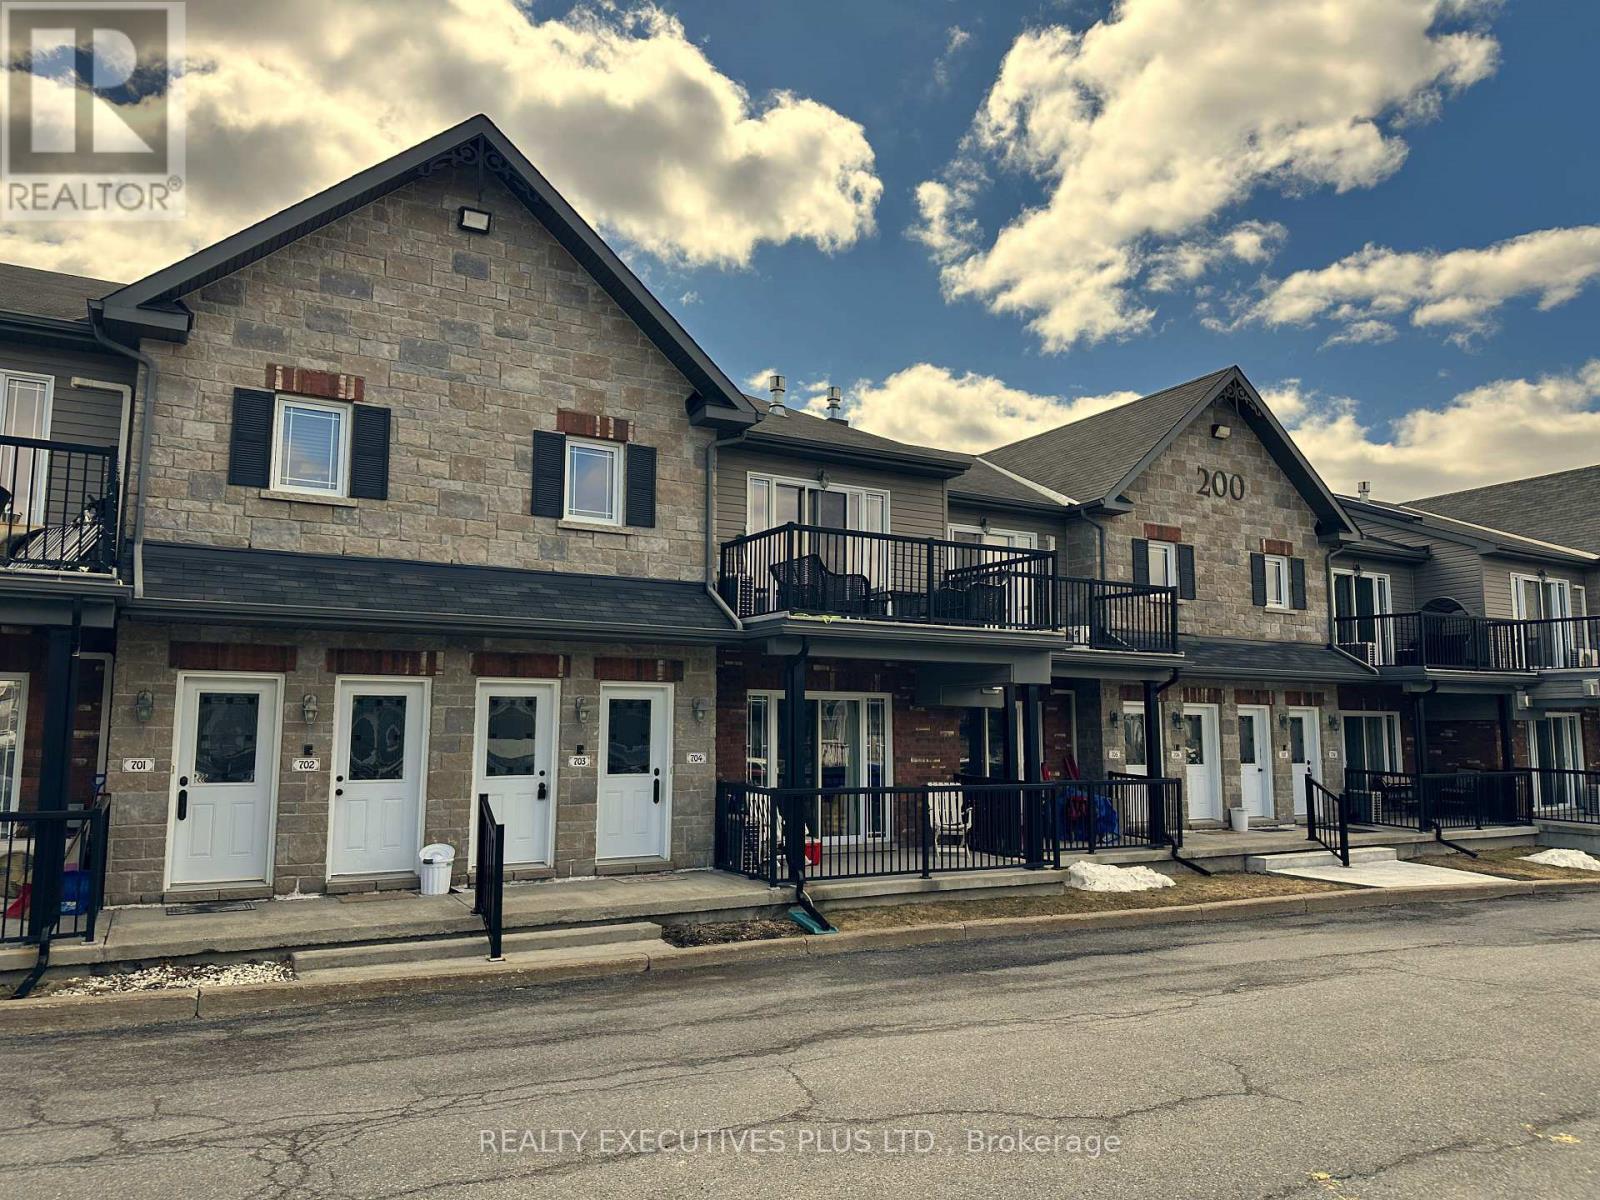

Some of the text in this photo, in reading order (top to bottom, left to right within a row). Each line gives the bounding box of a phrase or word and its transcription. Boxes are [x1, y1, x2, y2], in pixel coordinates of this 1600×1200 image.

[1196, 465, 1245, 501] 200
[573, 757, 586, 766] 703
[690, 754, 703, 763] 704
[131, 760, 146, 770] 701
[298, 760, 315, 770] 702
